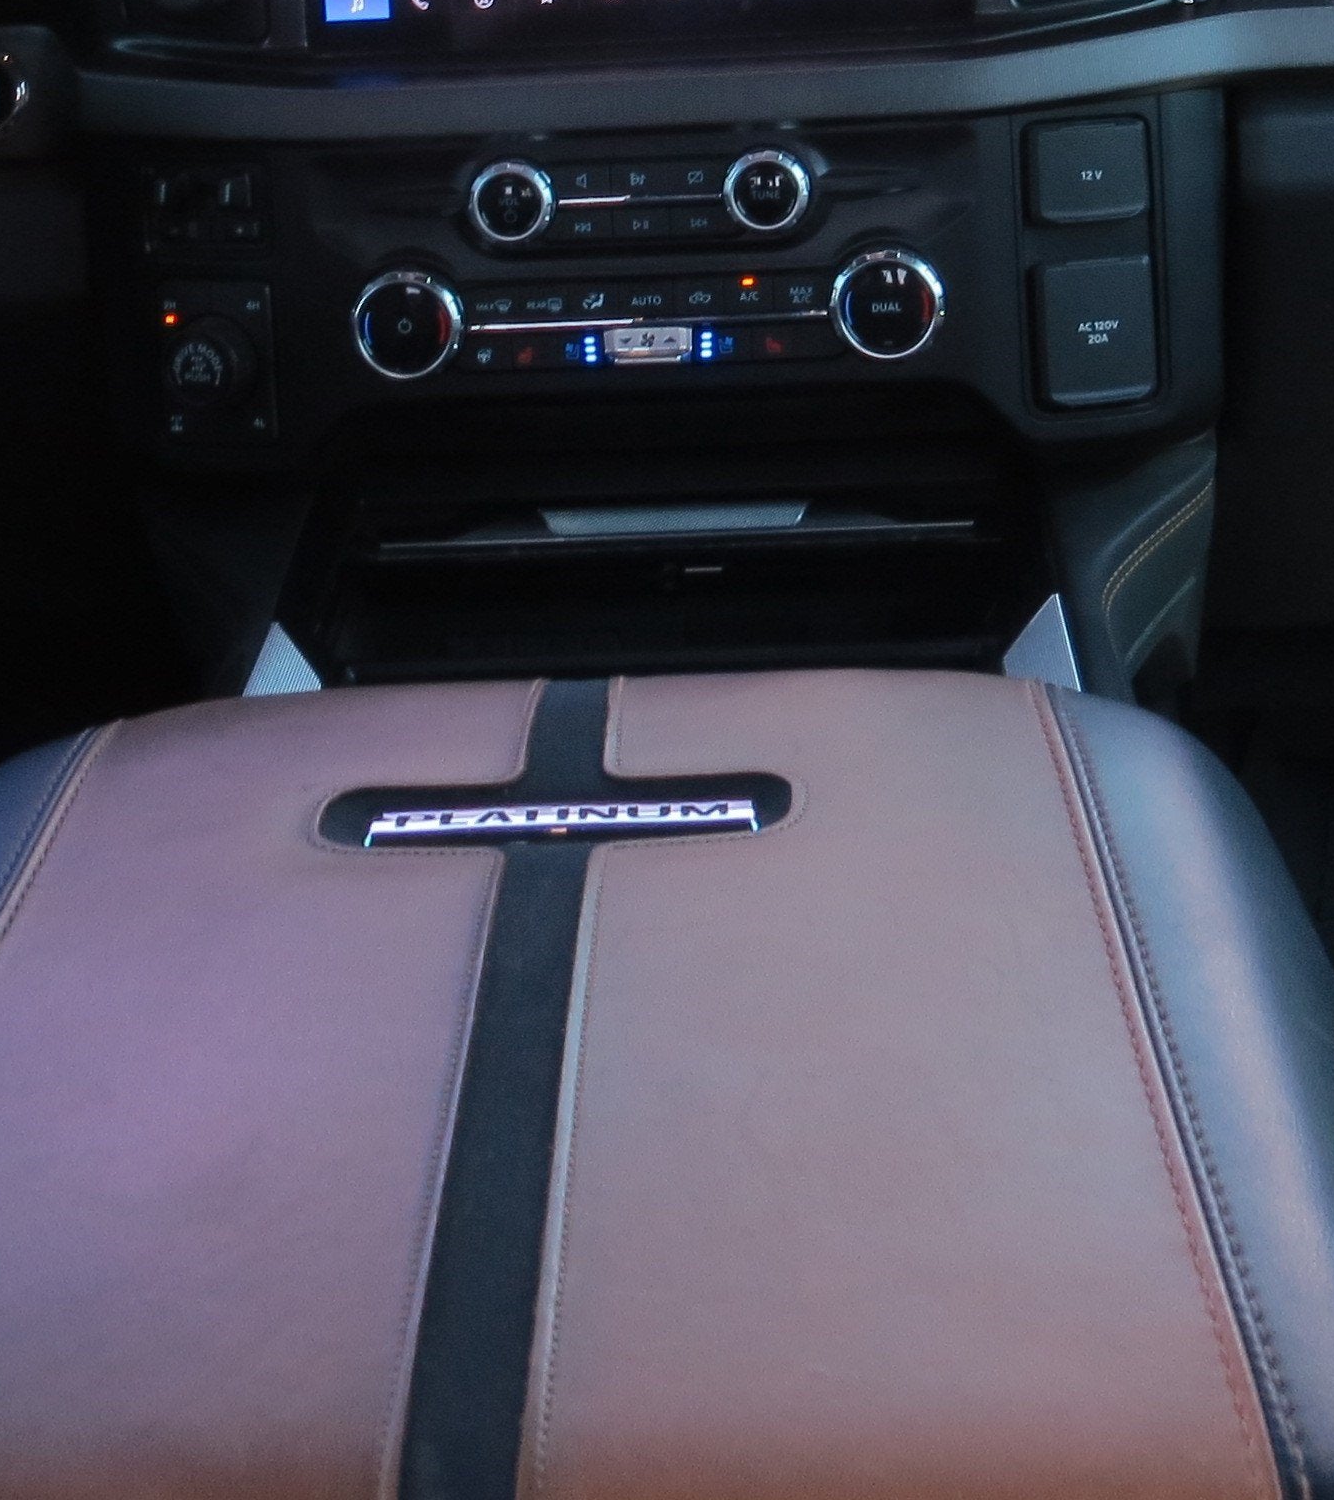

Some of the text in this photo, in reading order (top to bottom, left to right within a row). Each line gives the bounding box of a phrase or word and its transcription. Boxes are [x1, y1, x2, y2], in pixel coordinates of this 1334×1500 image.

[1080, 170, 1103, 181] 12 V
[631, 295, 662, 306] AUTO
[739, 291, 760, 302] A/C
[245, 300, 261, 311] 4H
[871, 302, 902, 313] DUAL
[1078, 320, 1118, 333] AC 120V
[1088, 334, 1109, 345] 20A
[395, 801, 730, 828] PLATINUM
